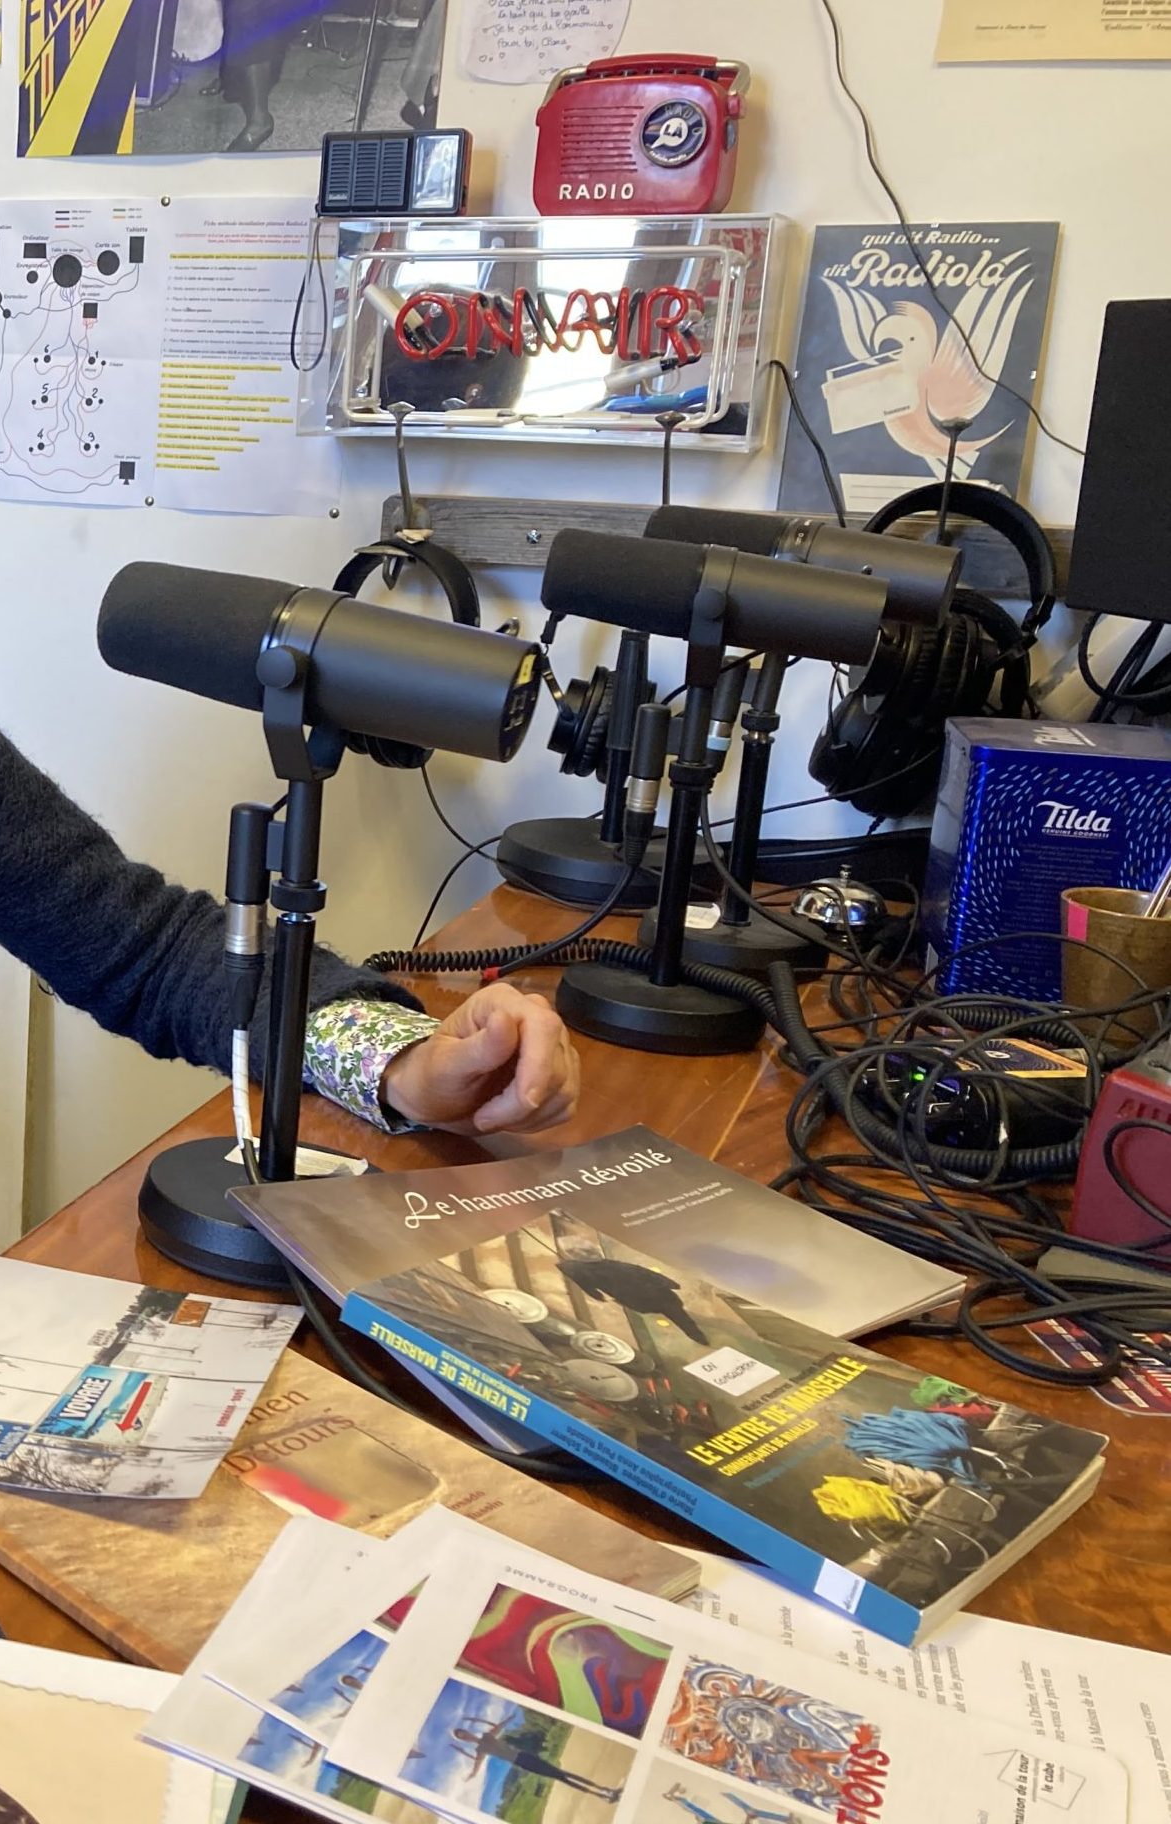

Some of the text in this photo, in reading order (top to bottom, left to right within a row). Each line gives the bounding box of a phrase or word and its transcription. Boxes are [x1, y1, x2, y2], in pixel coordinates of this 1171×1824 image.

[558, 182, 635, 201] RADIO
[861, 232, 895, 248] qui
[895, 231, 923, 244] dit
[823, 249, 1006, 288] dit Radiola
[395, 287, 523, 360] ON
[553, 287, 693, 365] AIR
[44, 344, 50, 353] 6
[95, 350, 99, 359] 1
[42, 383, 49, 394] 5
[92, 388, 98, 398] 2
[37, 428, 44, 439] 4
[1036, 800, 1112, 832] Tilda
[404, 1148, 672, 1229] Le hammam dévoilé
[370, 1321, 528, 1421] LE VENTRE DE MARSEILLE
[59, 1377, 109, 1420] VOYAGE
[686, 1445, 724, 1466] LE
[705, 1416, 777, 1455] VENTRE
[760, 1404, 797, 1425] DE
[780, 1356, 868, 1413] MARSEILLE
[768, 1437, 784, 1452] DE
[505, 1565, 597, 1603] PROGRAMME
[1086, 1708, 1102, 1736] Maison
[1018, 1754, 1029, 1773] tour
[1016, 1774, 1028, 1784] la
[1041, 1762, 1055, 1793] le cube
[1014, 1784, 1027, 1796] de
